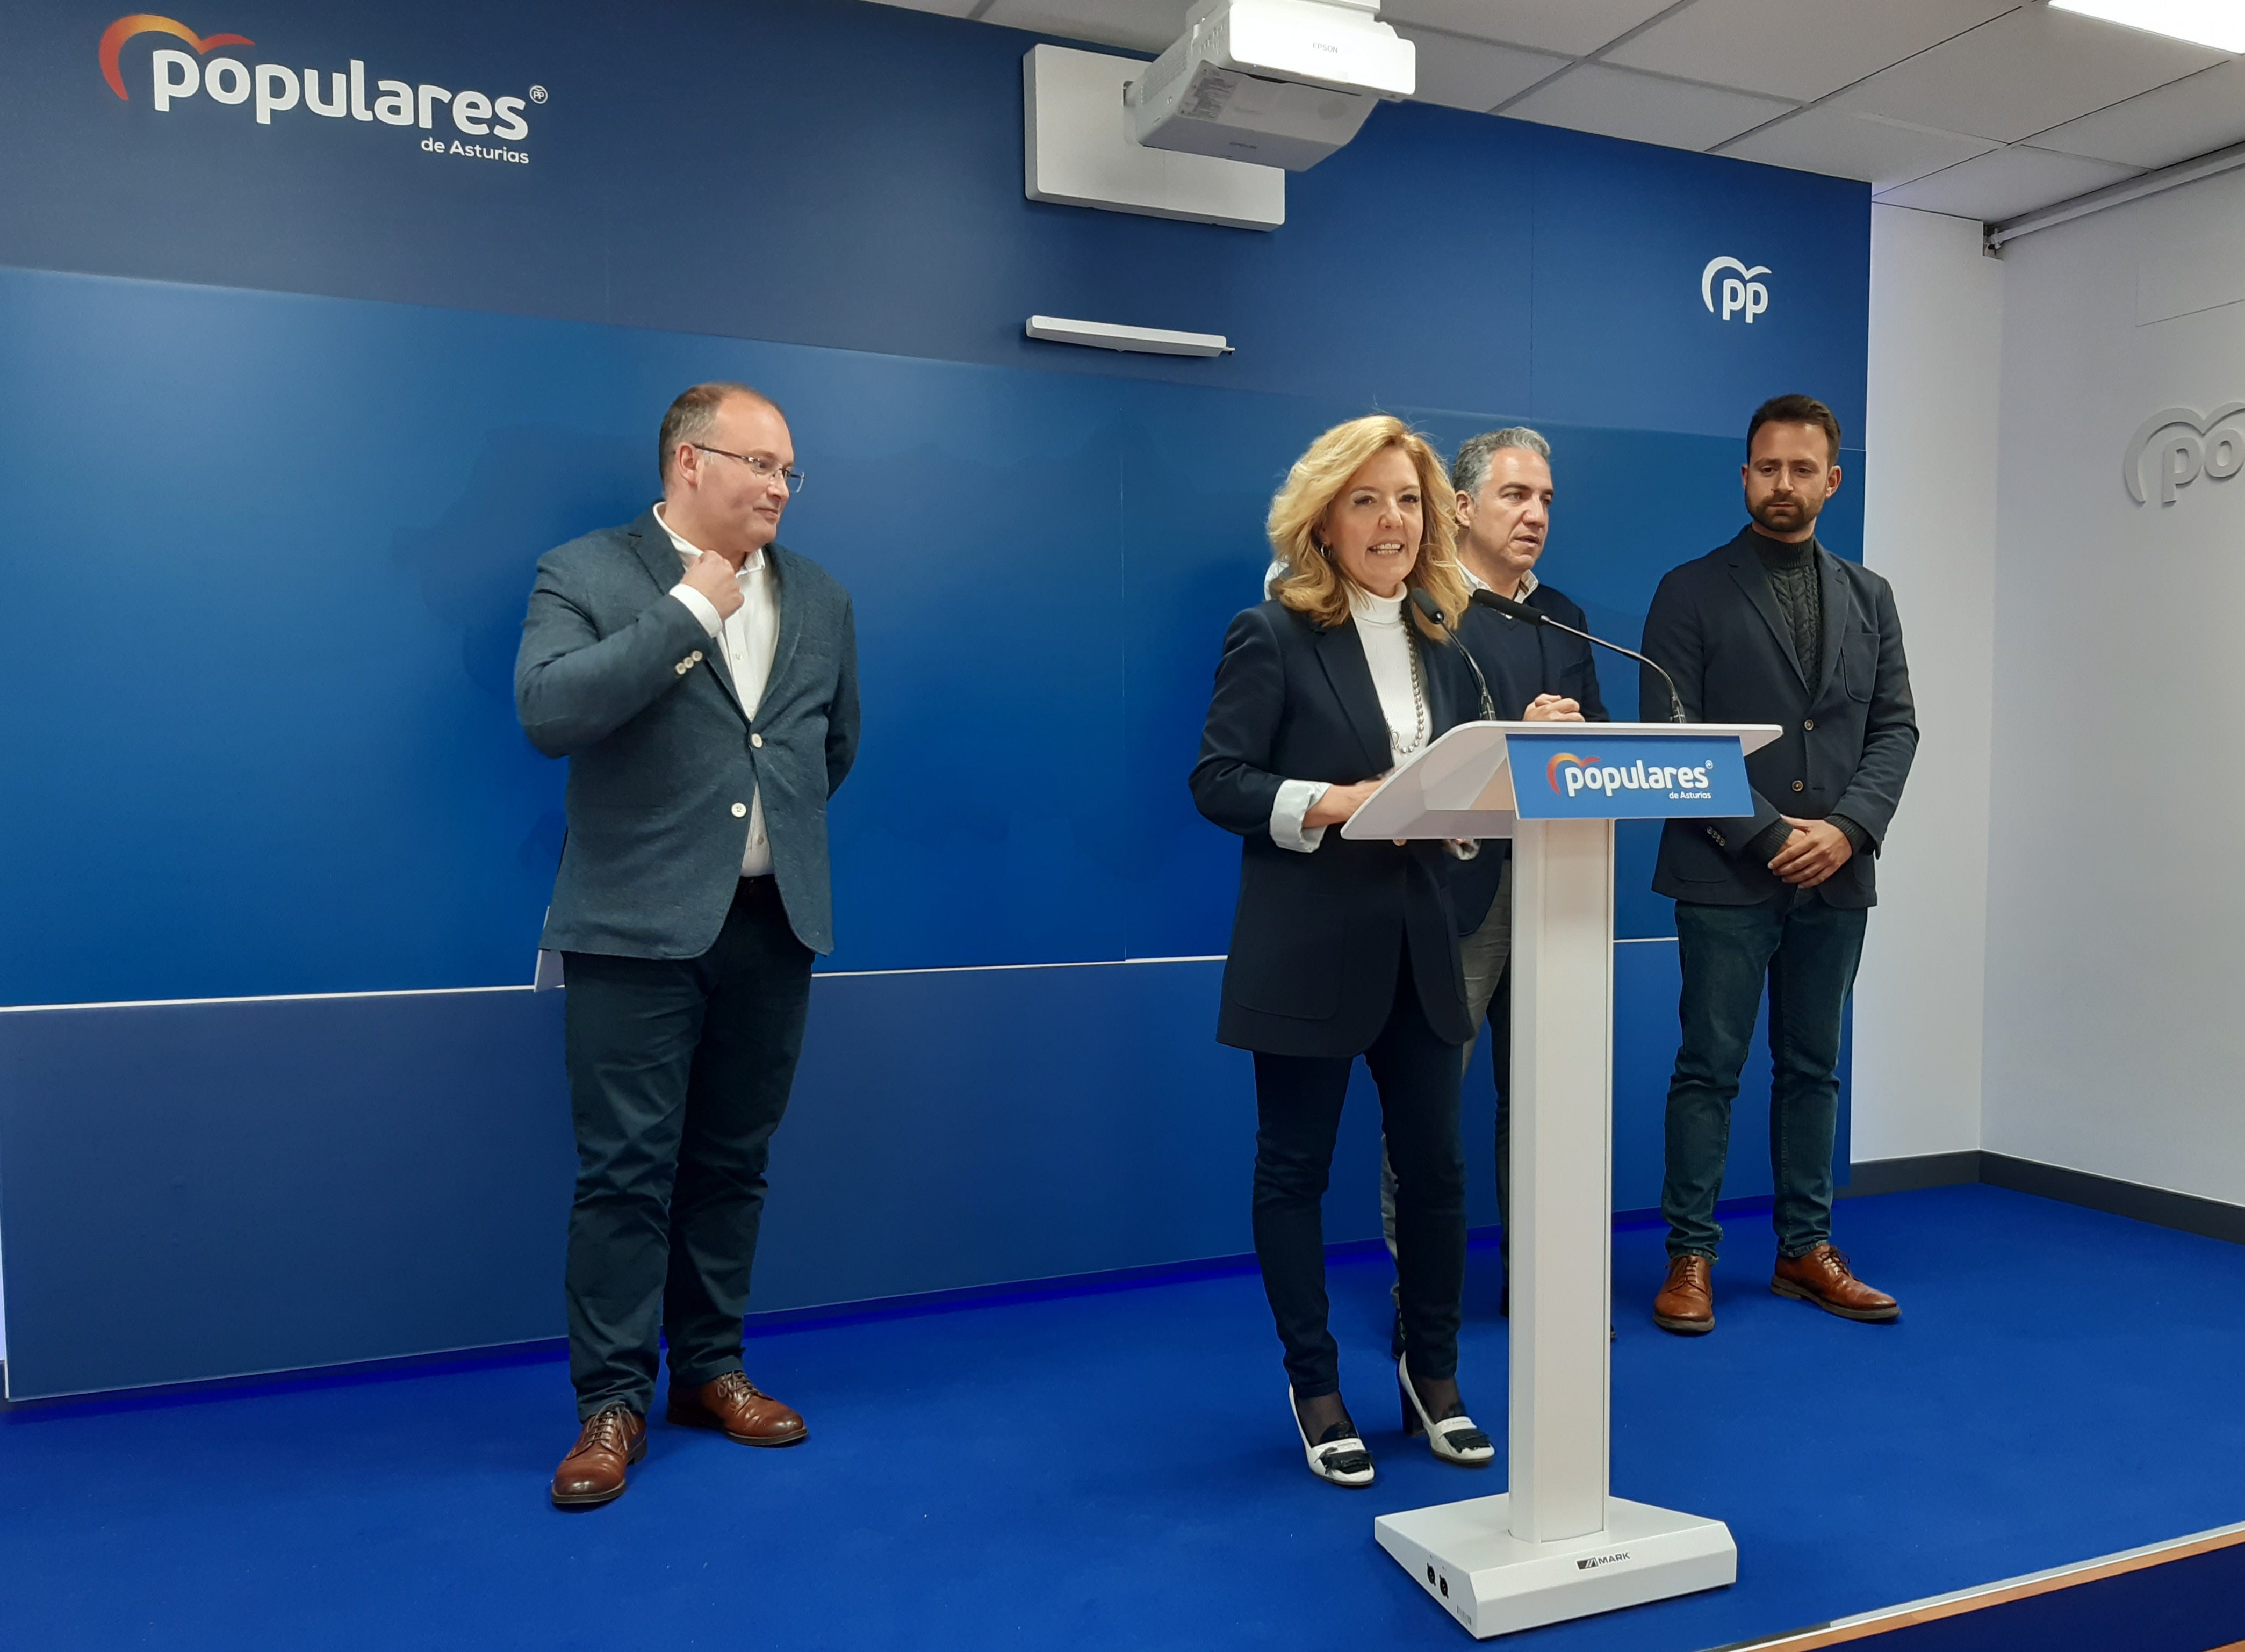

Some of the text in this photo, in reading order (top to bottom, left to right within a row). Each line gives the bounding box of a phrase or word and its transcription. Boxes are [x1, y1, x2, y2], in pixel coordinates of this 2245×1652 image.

[1312, 42, 1339, 54] EPSON
[152, 49, 528, 140] populares
[421, 136, 529, 164] de Asturias
[1564, 760, 1709, 797] populares
[1668, 791, 1711, 799] de Asturias
[1598, 1552, 1631, 1565] MARK
